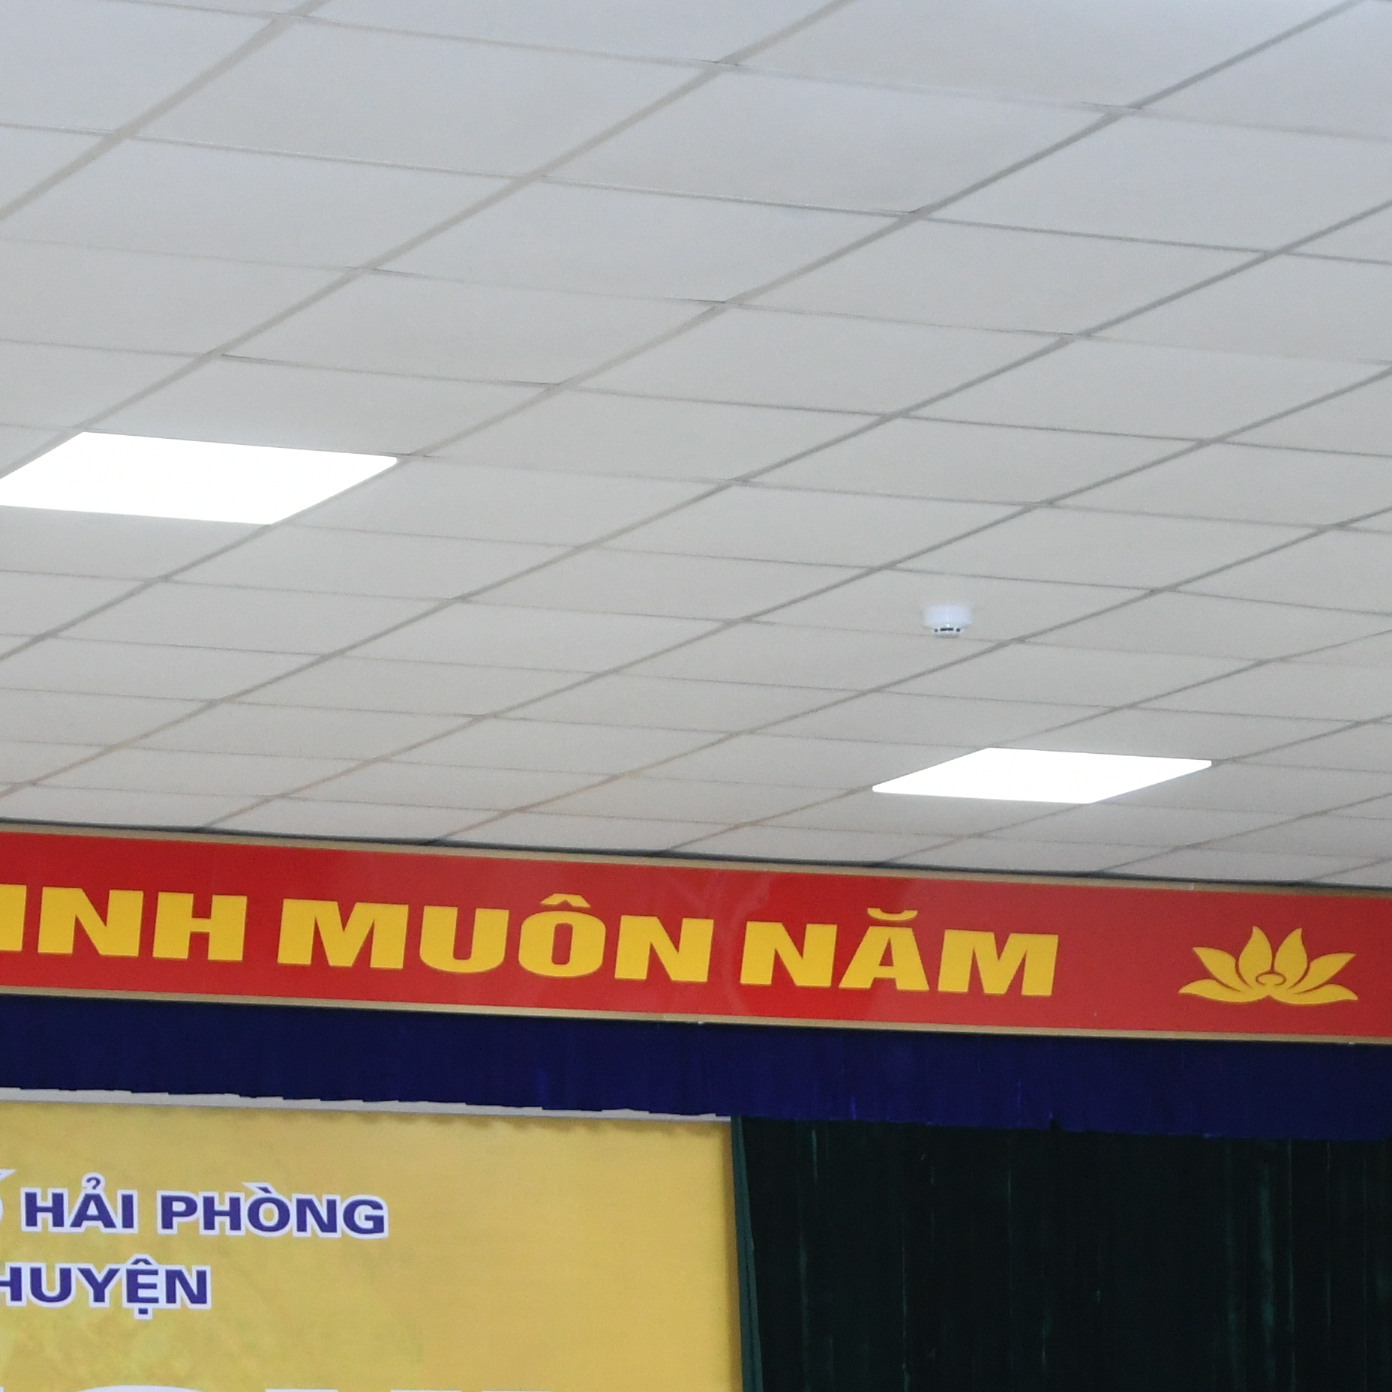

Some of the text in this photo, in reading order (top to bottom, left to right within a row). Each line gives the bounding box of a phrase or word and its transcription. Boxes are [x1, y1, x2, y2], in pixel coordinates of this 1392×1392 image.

[277, 893, 723, 983] MUÔN
[738, 906, 1060, 999] NĂM
[23, 1173, 137, 1232] HẢI
[158, 1183, 387, 1237] PHÒNG
